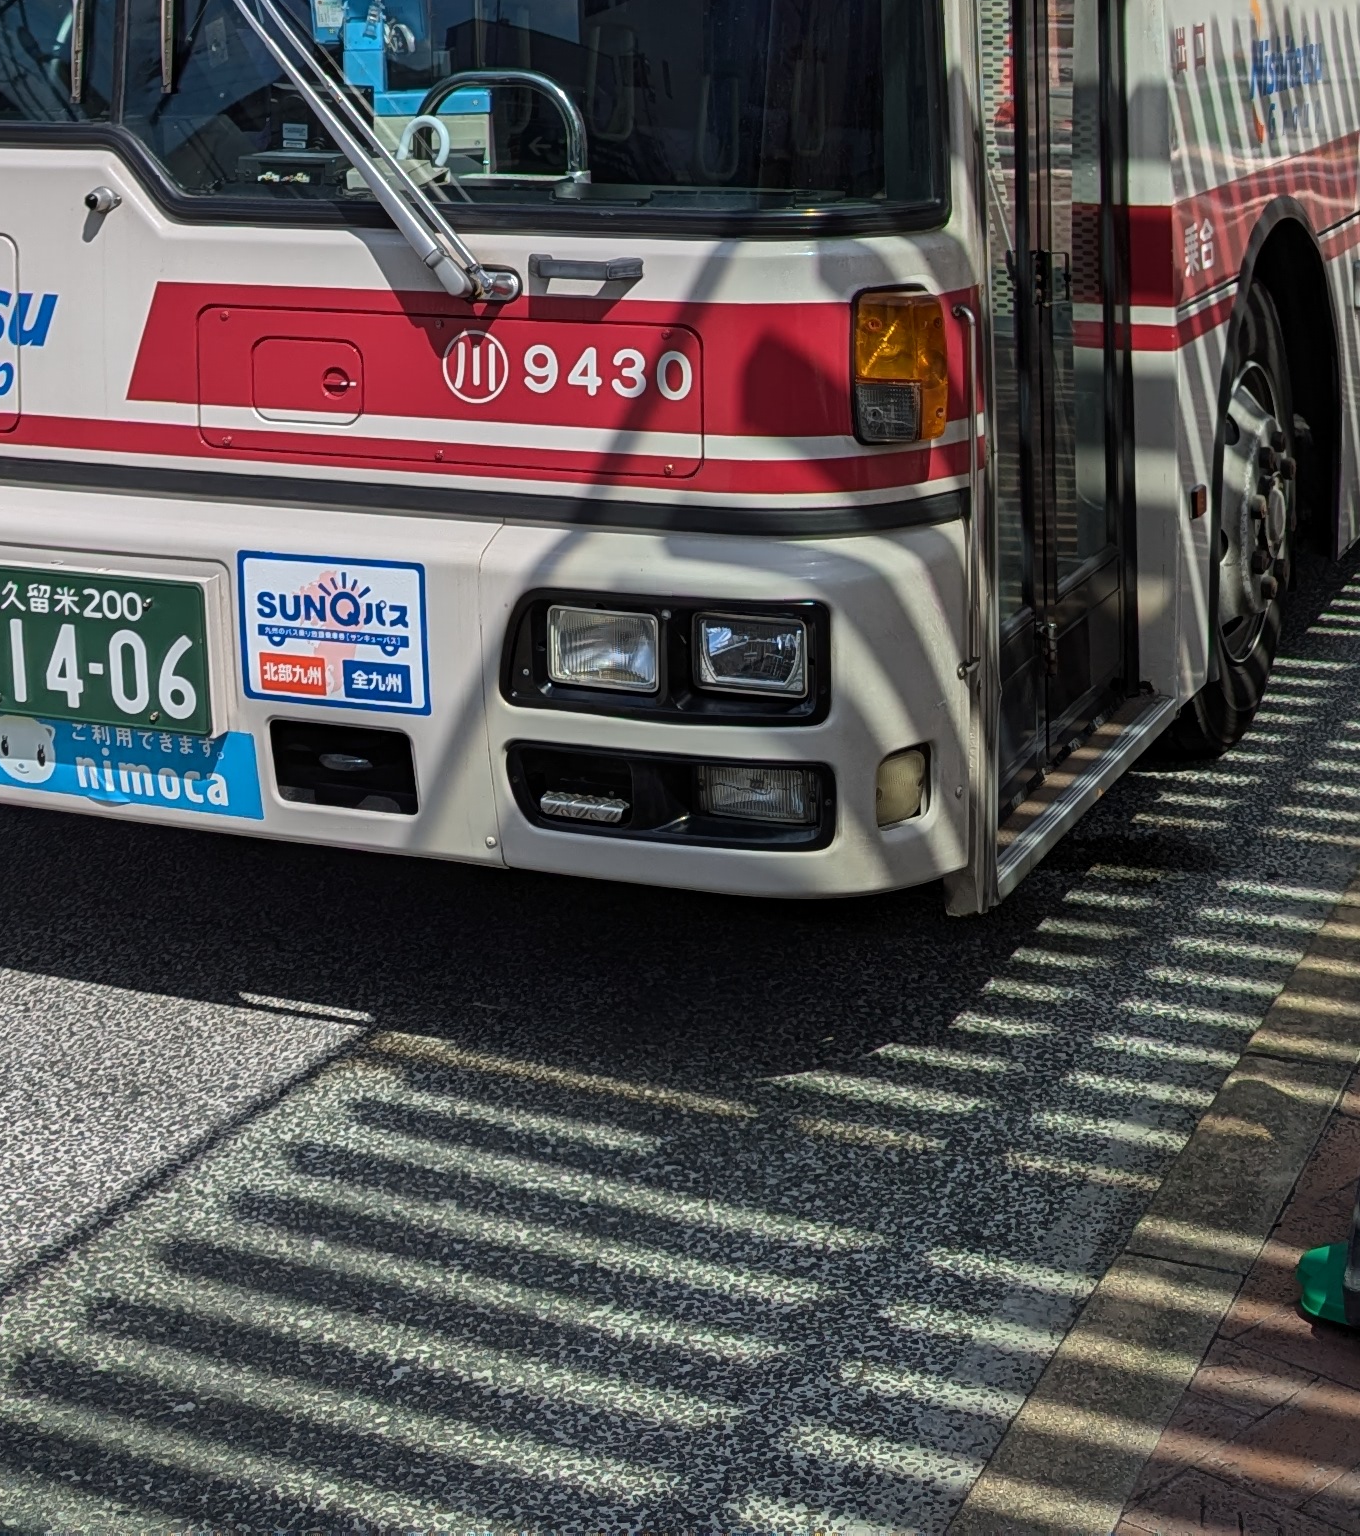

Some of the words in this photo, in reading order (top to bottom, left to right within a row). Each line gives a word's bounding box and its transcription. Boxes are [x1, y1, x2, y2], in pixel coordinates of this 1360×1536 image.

[1174, 21, 1207, 74] 出口
[523, 344, 692, 403] 9430
[9, 617, 197, 720] 14-06
[262, 661, 323, 687] 北部九州
[351, 669, 403, 694] 全九州
[74, 746, 230, 807] nimoca
